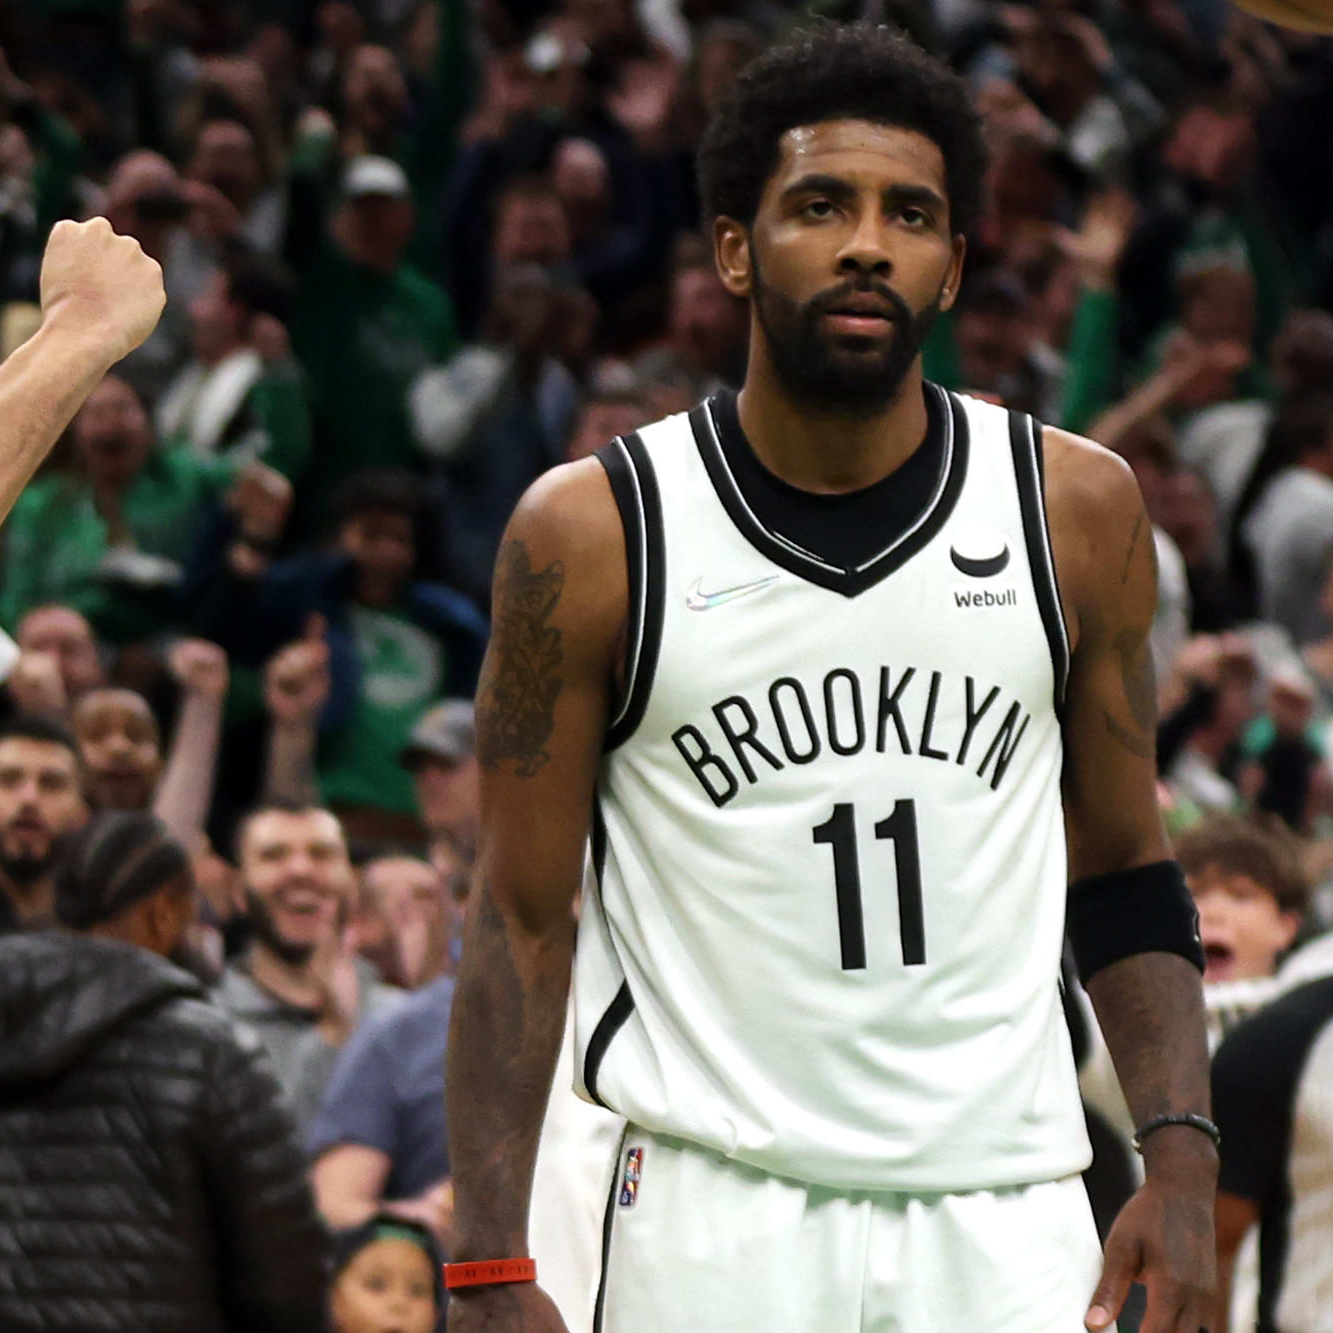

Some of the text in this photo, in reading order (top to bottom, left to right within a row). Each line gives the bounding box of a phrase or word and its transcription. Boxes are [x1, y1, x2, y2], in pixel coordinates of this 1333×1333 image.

[954, 588, 1017, 608] Webull
[671, 665, 1031, 809] BROOKLYN
[812, 798, 927, 970] 11
